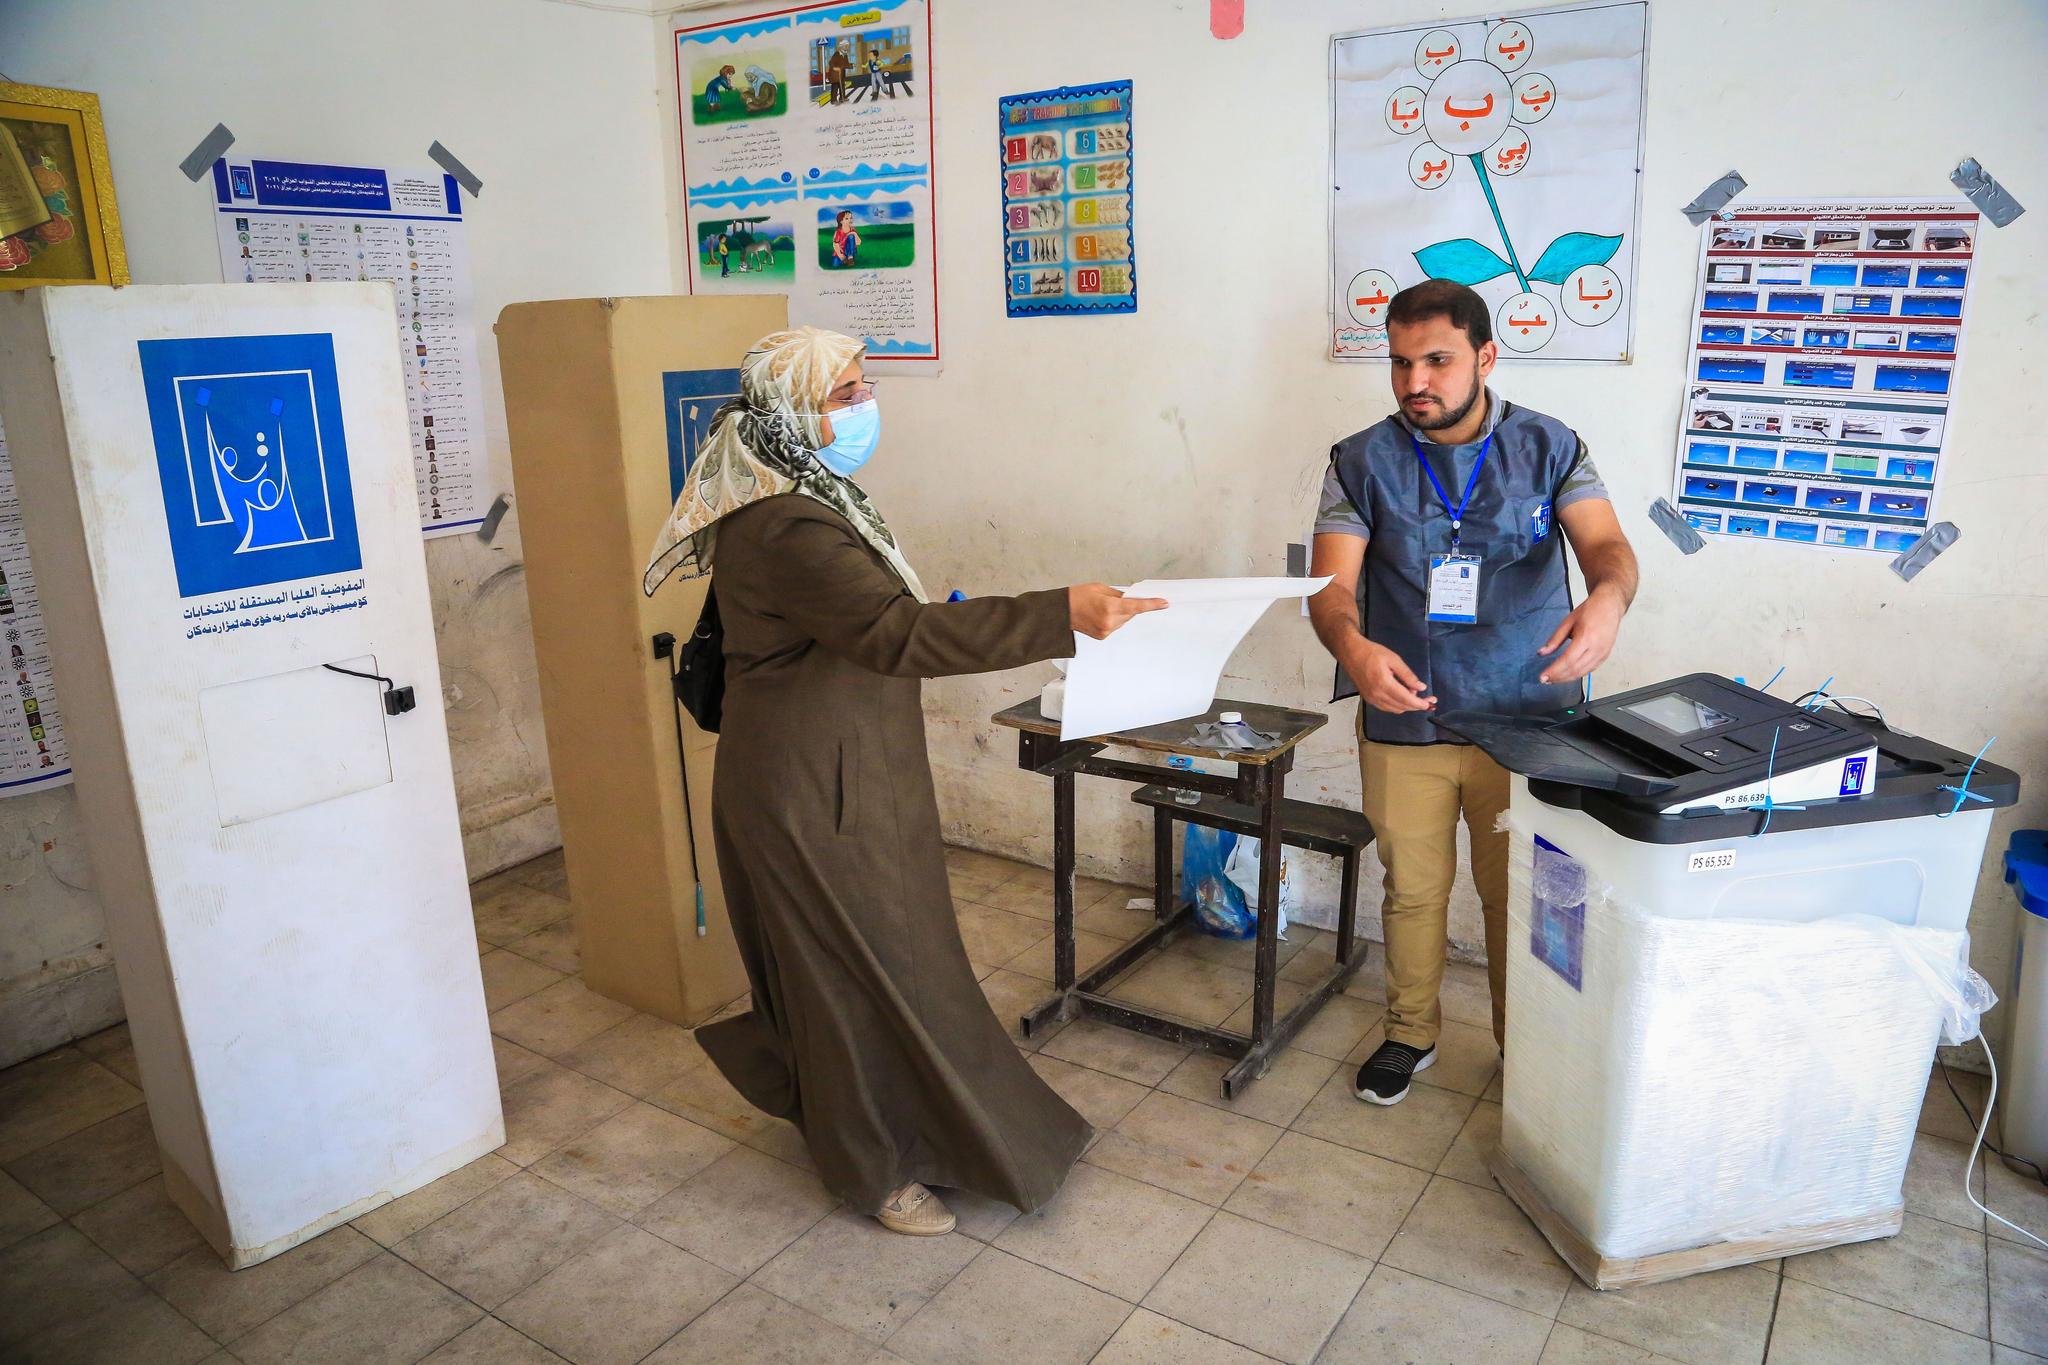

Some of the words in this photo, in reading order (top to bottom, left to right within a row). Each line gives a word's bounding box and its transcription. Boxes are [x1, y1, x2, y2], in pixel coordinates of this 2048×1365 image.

[1444, 92, 1494, 132] ب
[1082, 133, 1090, 148] 6
[1013, 141, 1020, 156] 1
[1015, 174, 1022, 190] 2
[1082, 167, 1090, 183] 7
[1016, 209, 1024, 224] 3
[1083, 203, 1090, 218] 8
[1016, 242, 1024, 257] 4
[1082, 237, 1090, 252] 9
[1018, 275, 1026, 290] 5
[1081, 271, 1097, 288] 10
[291, 586, 318, 604] العليا
[320, 578, 366, 598] المفوضية
[239, 591, 288, 610] المستقلة
[183, 600, 236, 620] للانتخابات
[1725, 796, 1735, 804] PS
[1737, 793, 1765, 803] 86,639
[1692, 857, 1703, 868] PS
[1705, 855, 1732, 868] 65,532
